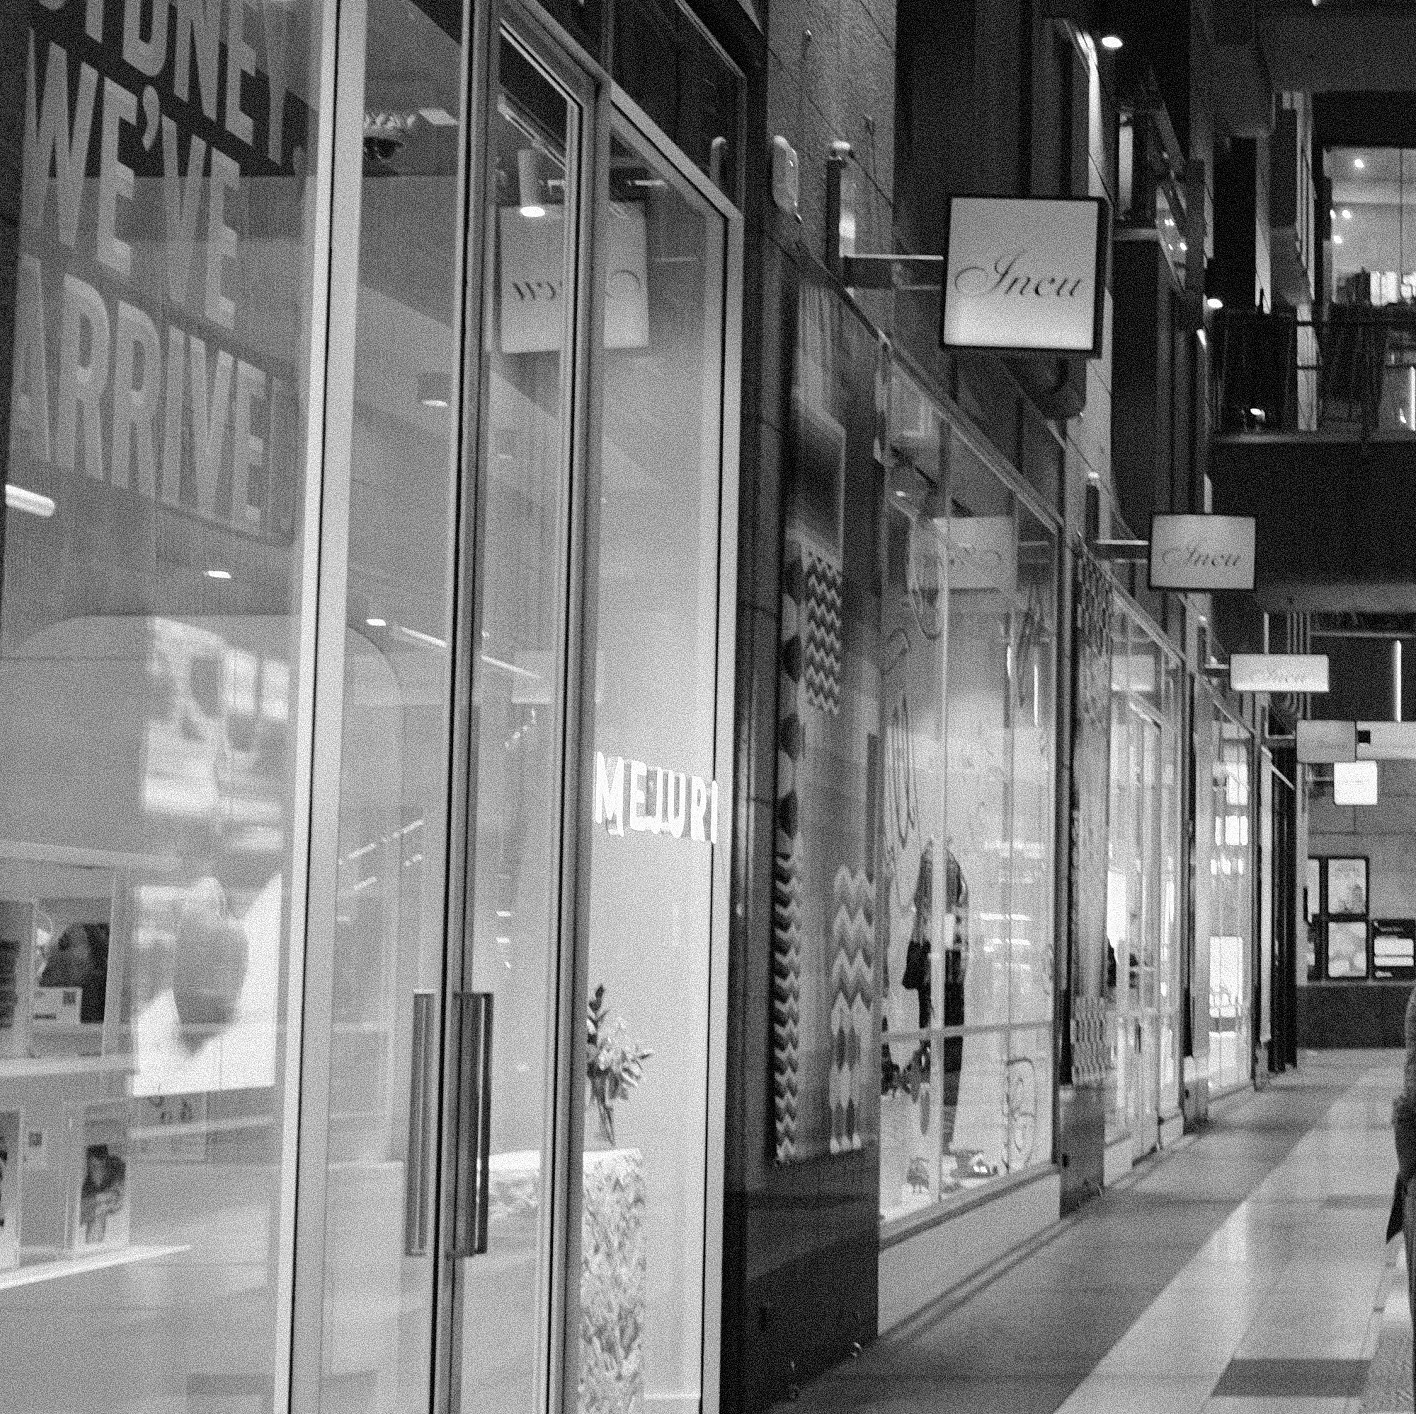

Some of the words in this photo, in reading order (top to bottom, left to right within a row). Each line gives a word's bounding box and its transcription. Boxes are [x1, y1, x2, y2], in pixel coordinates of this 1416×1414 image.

[953, 247, 1084, 300] Incu
[1158, 536, 1242, 569] Incu
[593, 751, 719, 844] MEJURI
